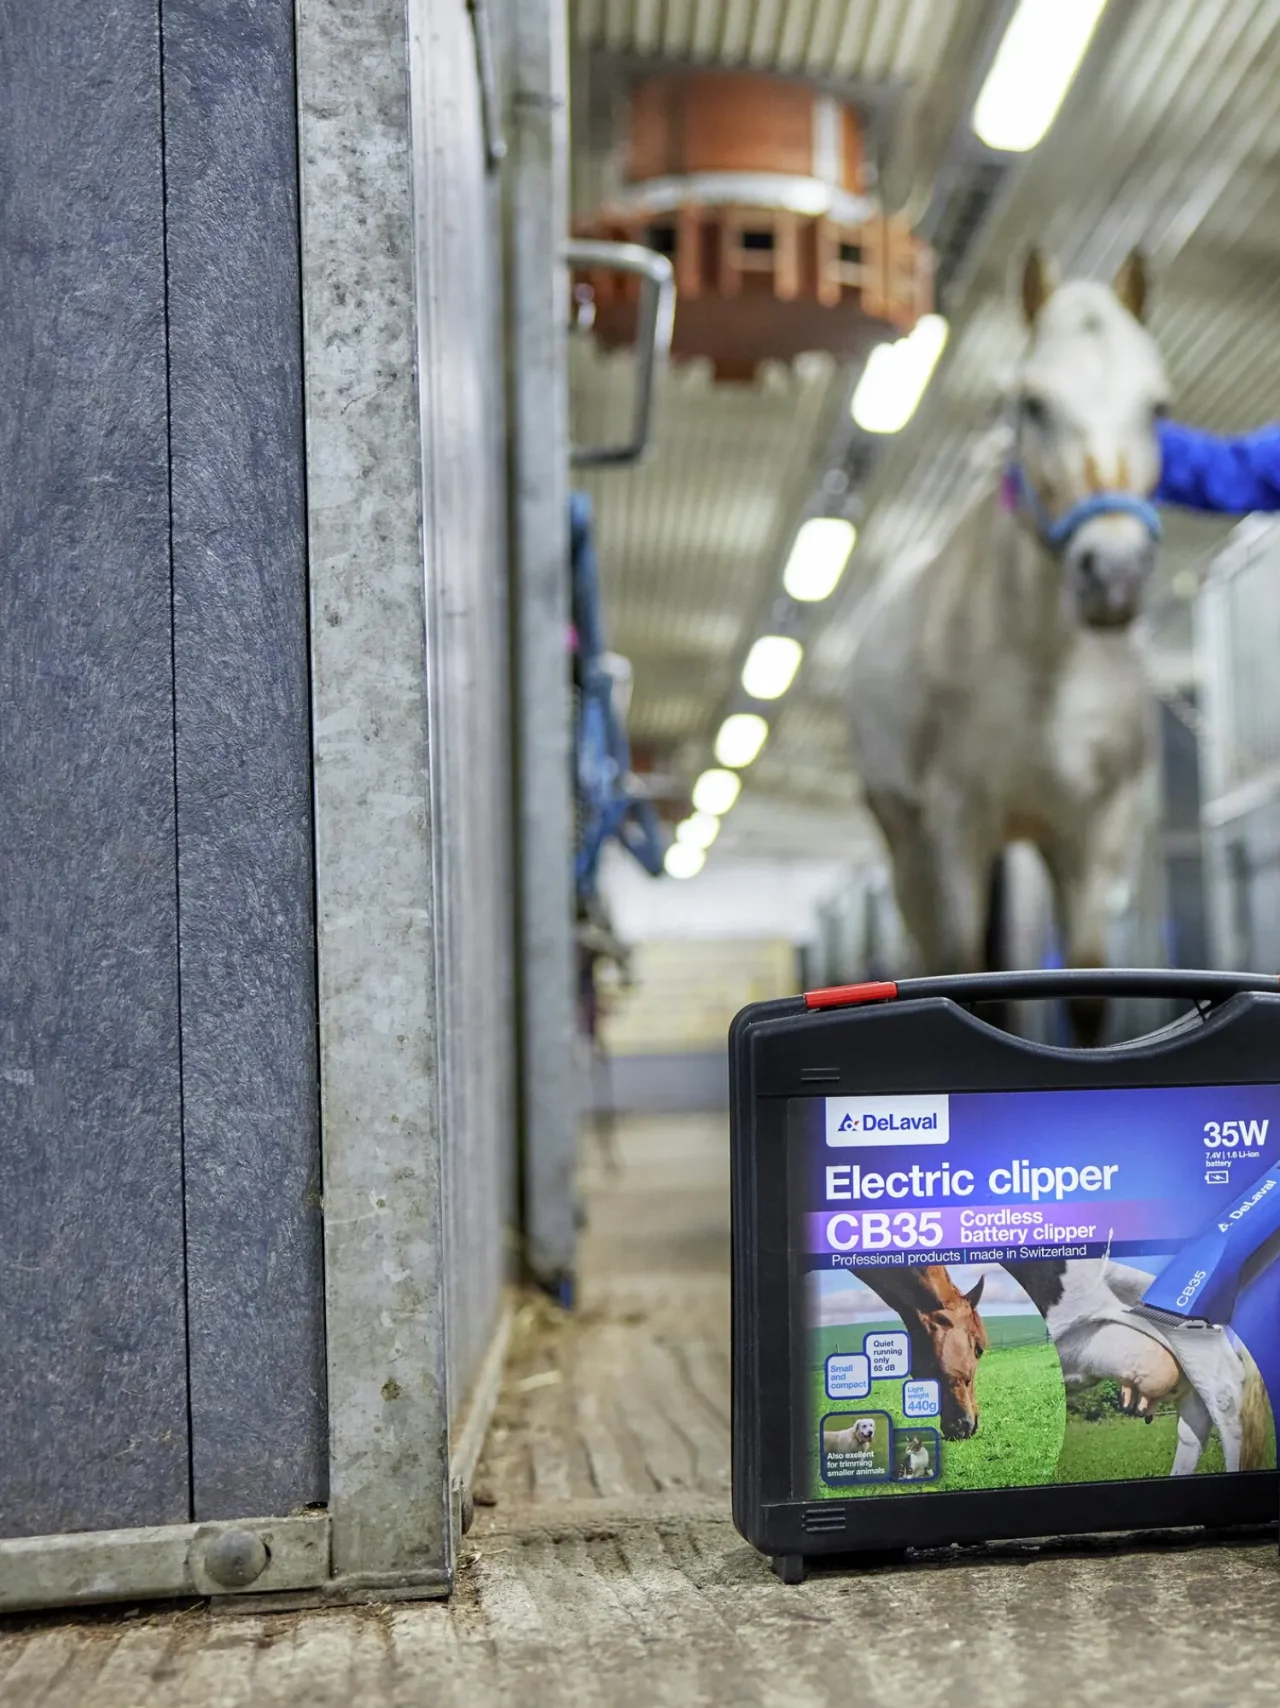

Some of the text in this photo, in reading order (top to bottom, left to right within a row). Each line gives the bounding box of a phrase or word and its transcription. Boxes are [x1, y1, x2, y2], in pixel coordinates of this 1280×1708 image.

[862, 1113, 938, 1131] DeLaval
[1203, 1120, 1269, 1148] 35W
[1205, 1151, 1222, 1160] 7.4V
[1239, 1150, 1260, 1159] Li-ion
[1205, 1160, 1232, 1169] battery
[825, 1160, 1119, 1200] Electric clipper
[1229, 1180, 1278, 1220] DeLaval
[960, 1209, 1044, 1227] Cordless
[826, 1212, 944, 1250] CB35
[960, 1223, 1097, 1245] battery clipper
[831, 1244, 1087, 1267] Professional products made in Switzerland
[1176, 1270, 1207, 1307] CB35
[873, 1340, 894, 1348] Quiet
[873, 1348, 903, 1356] running
[873, 1356, 890, 1364] only
[830, 1364, 853, 1373] Small
[873, 1364, 896, 1372] 65 dB
[830, 1373, 846, 1381] and
[830, 1381, 867, 1390] compact
[907, 1392, 930, 1400] weight
[907, 1400, 937, 1413] 440g
[826, 1452, 844, 1460] Also
[826, 1459, 873, 1469] for trimming
[826, 1467, 885, 1477] smaller animals
